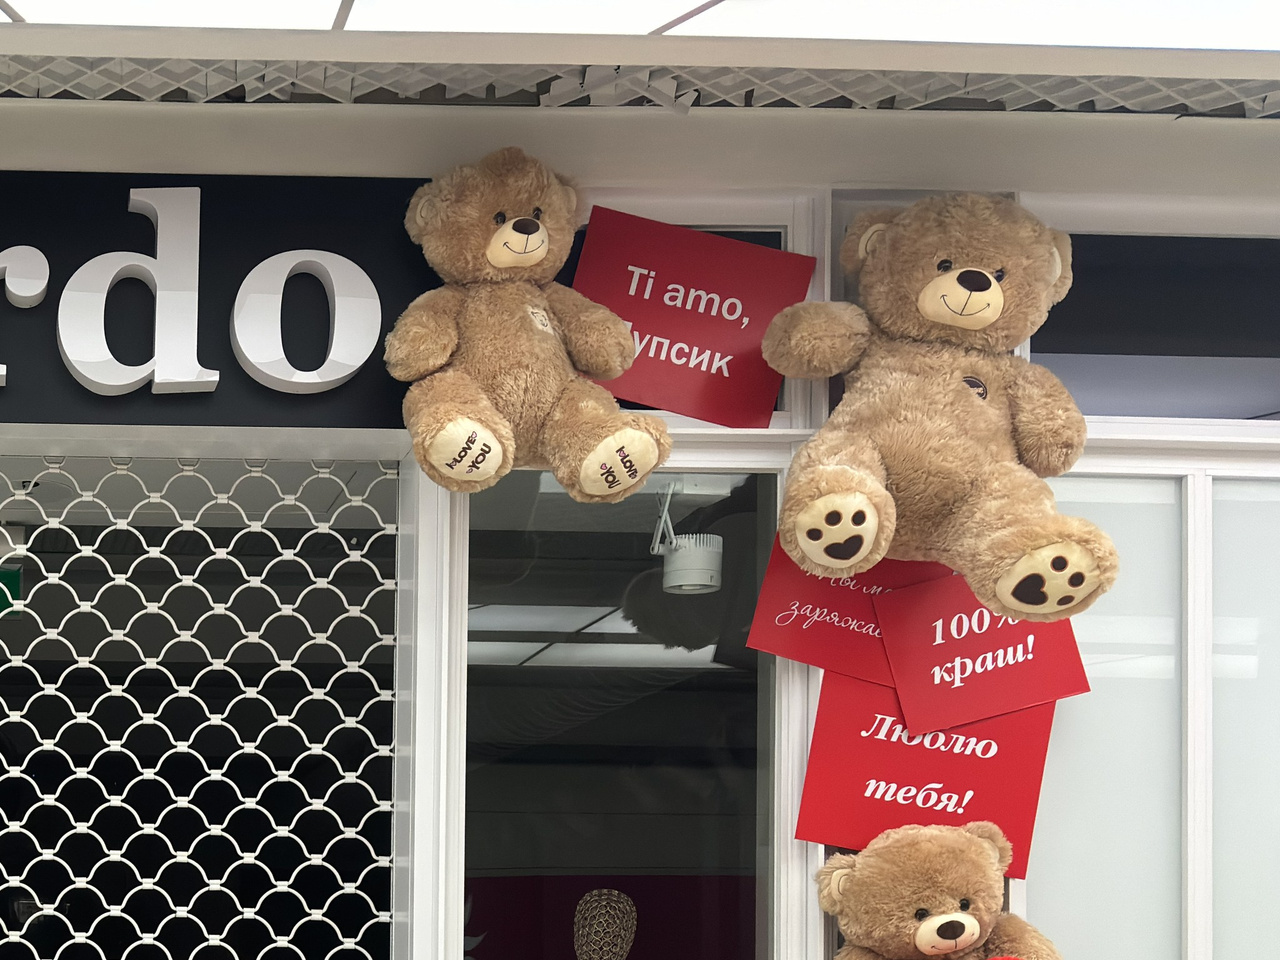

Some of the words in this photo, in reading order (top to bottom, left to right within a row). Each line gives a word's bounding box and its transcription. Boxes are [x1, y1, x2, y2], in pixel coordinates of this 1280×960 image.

[626, 264, 656, 301] Ti
[663, 282, 750, 330] amo,
[622, 319, 734, 378] упсик
[453, 436, 477, 465] LOVE
[470, 442, 492, 472] YOU
[620, 453, 638, 479] LOVE
[601, 466, 623, 489] YOU
[930, 633, 1035, 689] краш!
[863, 778, 975, 814] тебя!
